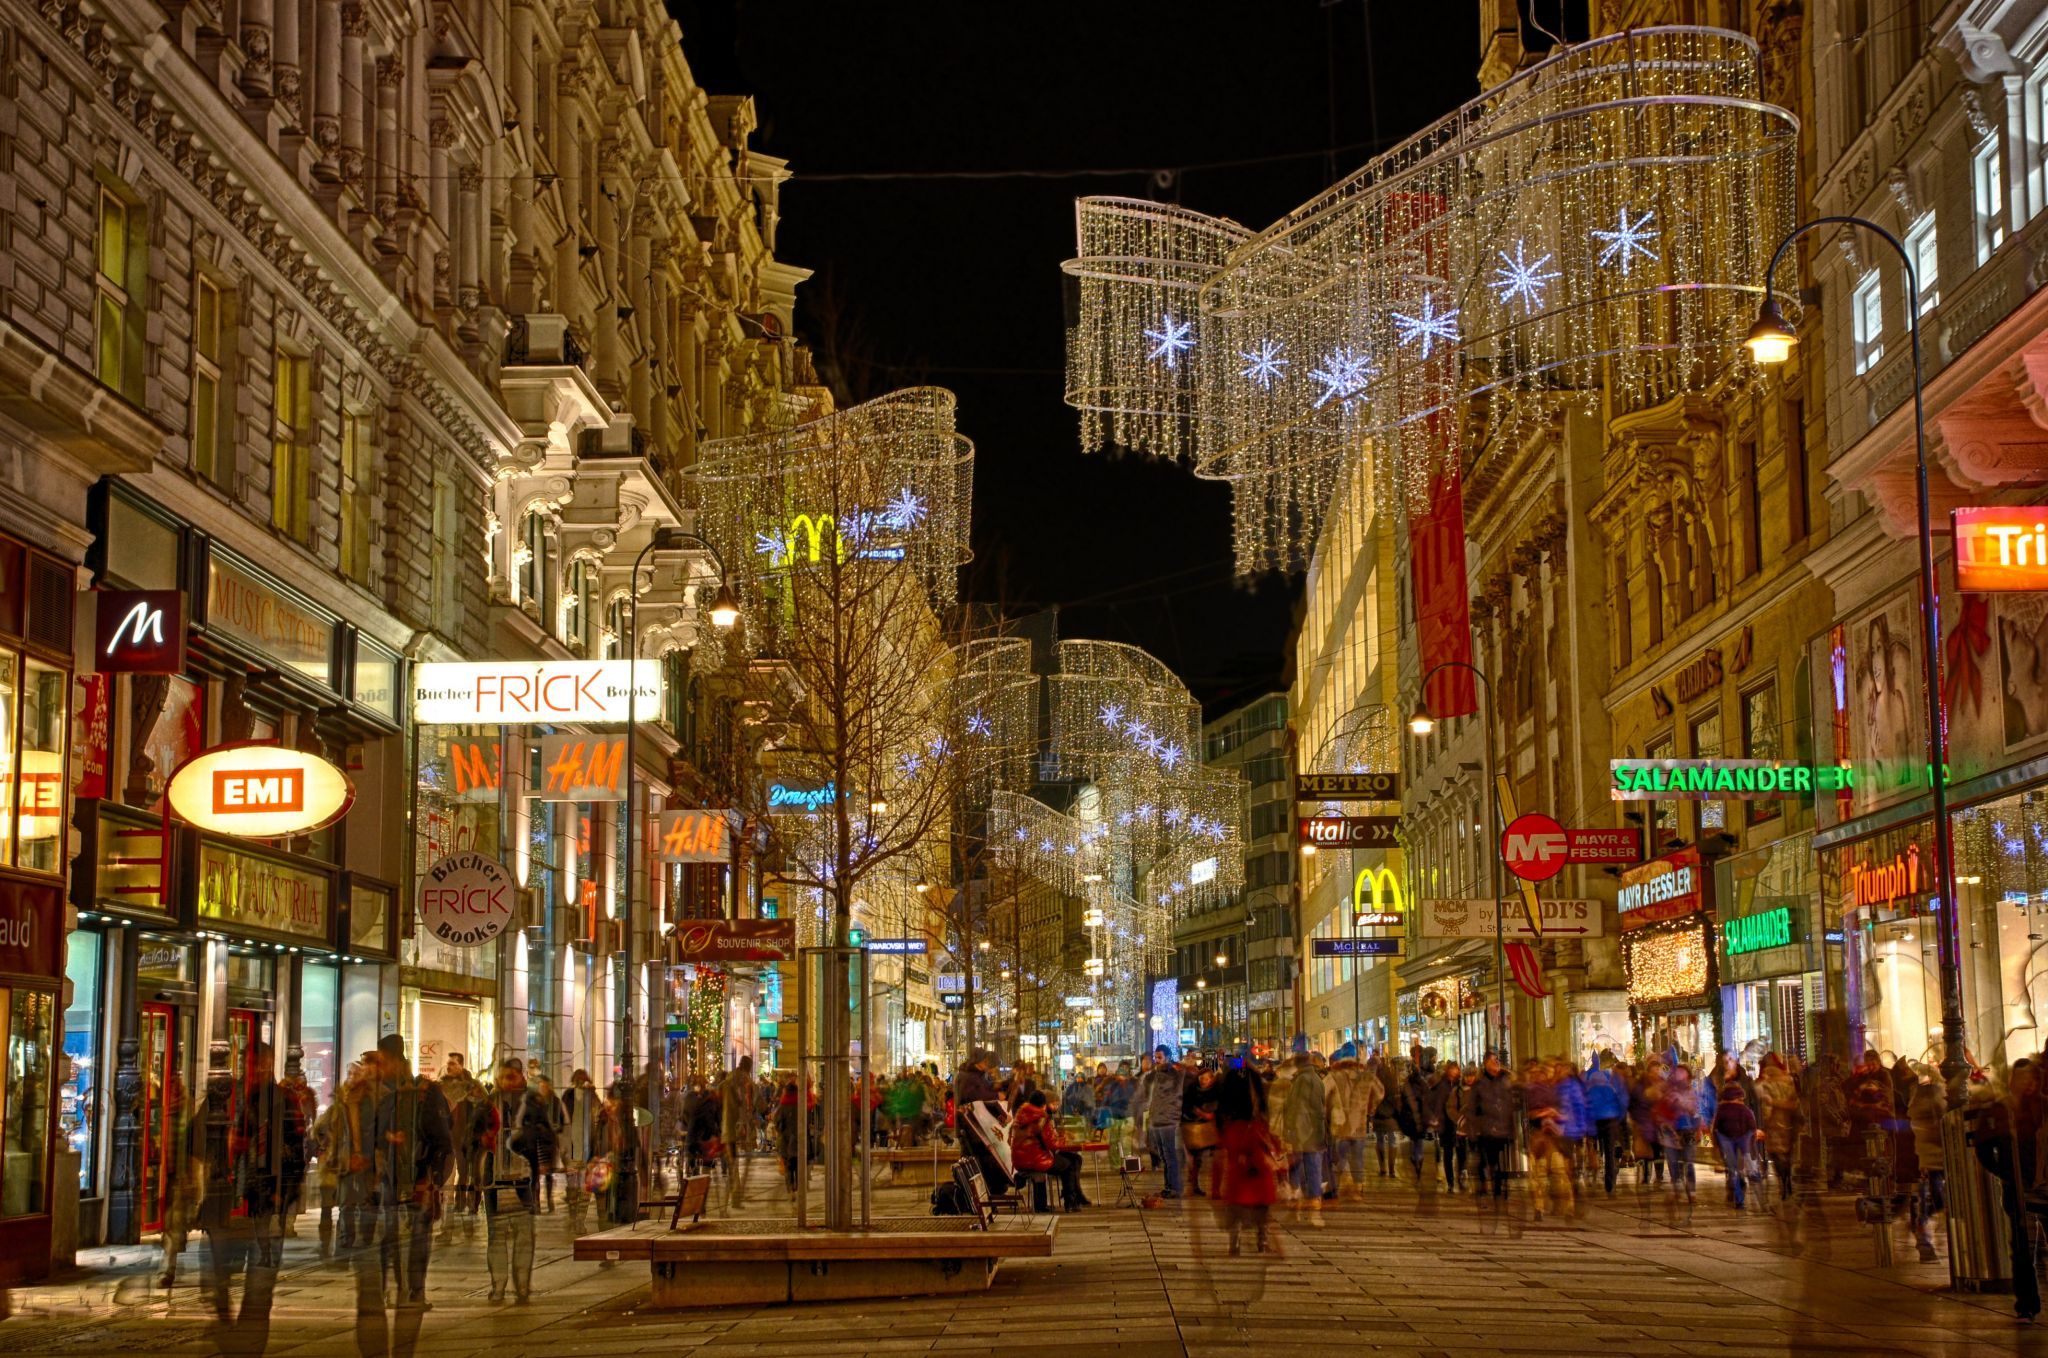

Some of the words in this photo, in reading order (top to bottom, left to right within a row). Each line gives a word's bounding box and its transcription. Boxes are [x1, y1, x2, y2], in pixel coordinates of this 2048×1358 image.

[215, 573, 273, 641] MUSIC
[276, 605, 326, 652] STORE
[417, 687, 474, 700] Bücher
[606, 685, 657, 698] Books
[547, 740, 625, 793] H&M
[1615, 765, 1811, 792] SALAMANDER
[224, 778, 293, 805] EMI
[1299, 775, 1390, 791] METRO
[663, 816, 725, 857] H&M
[1309, 820, 1364, 841] italic
[1575, 834, 1618, 845] MAYR
[1621, 835, 1630, 844] &
[1506, 834, 1568, 861] MF
[1570, 847, 1636, 857] FESSLER
[431, 854, 503, 883] Bücher
[208, 861, 240, 908] EMI
[248, 871, 319, 925] AUSTRIA
[1617, 882, 1641, 914] MAYR
[1643, 886, 1650, 907] &
[1650, 866, 1692, 904] FESSLER
[1851, 854, 1906, 912] Triumph
[1434, 901, 1468, 912] MCM
[1479, 908, 1494, 921] by
[1501, 902, 1588, 919] TADI'S
[436, 920, 498, 944] Books
[717, 938, 761, 949] SOUVENIR
[766, 938, 790, 948] SHOP
[1725, 906, 1791, 956] SALAMANDER
